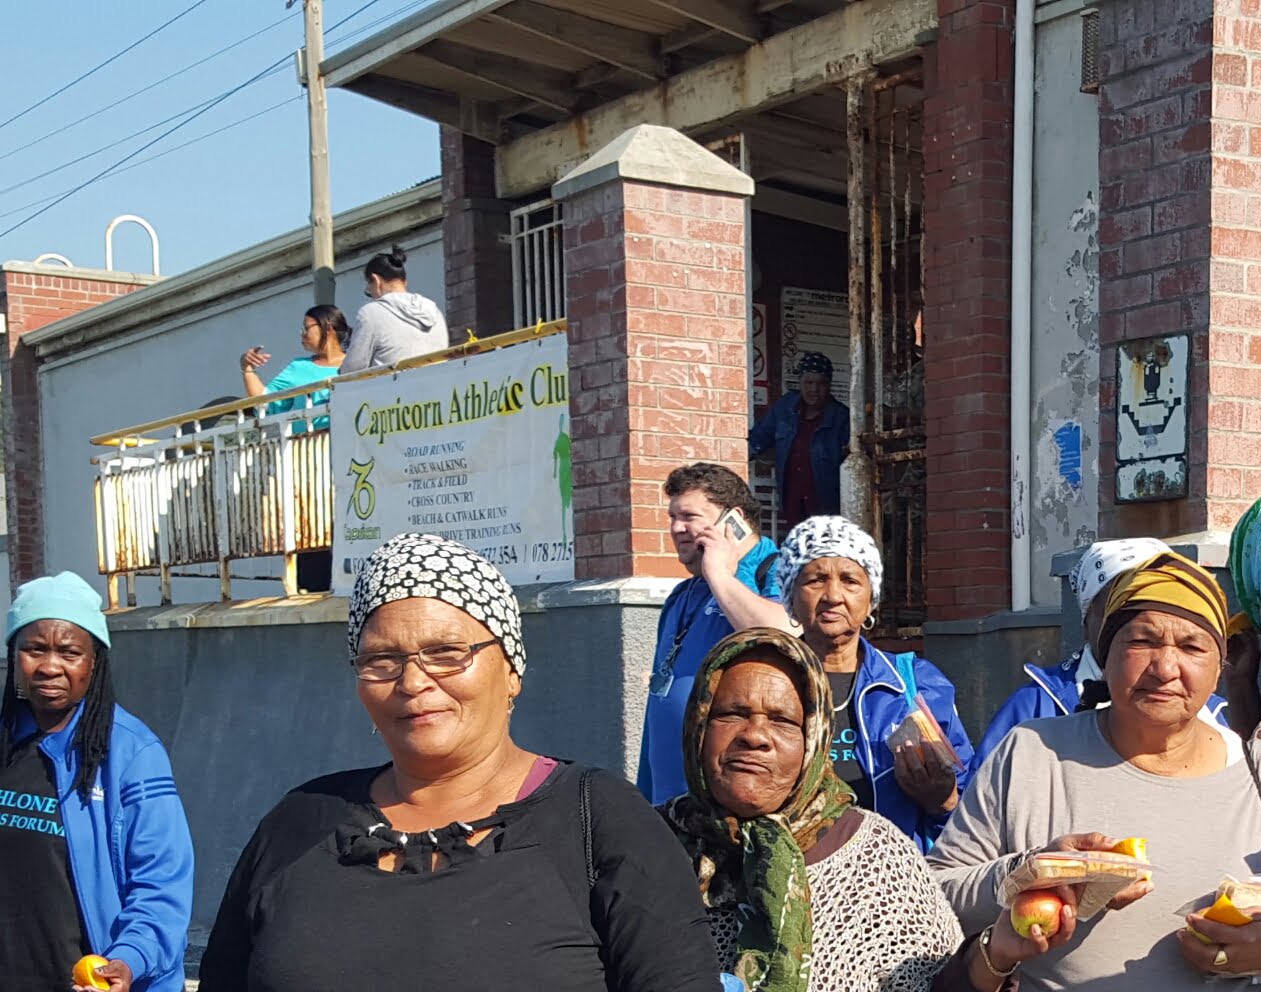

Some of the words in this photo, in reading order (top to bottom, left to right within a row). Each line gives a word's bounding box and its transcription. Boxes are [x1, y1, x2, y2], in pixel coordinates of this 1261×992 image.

[355, 397, 443, 444] Capricorn
[450, 376, 524, 424] Athletic
[530, 366, 567, 406] Clu
[406, 445, 428, 458] ROAD
[430, 440, 465, 456] RUNNING
[408, 461, 428, 475] RACE
[430, 458, 467, 472] WALKING
[413, 478, 436, 491] TRACK
[444, 474, 468, 487] FIELD
[411, 494, 435, 507] CROSS
[436, 491, 475, 506] COUNTRY
[412, 513, 436, 525] BEACH
[445, 508, 486, 523] CATWALK
[487, 506, 508, 520] RUNS
[8, 815, 65, 837] FORUM
